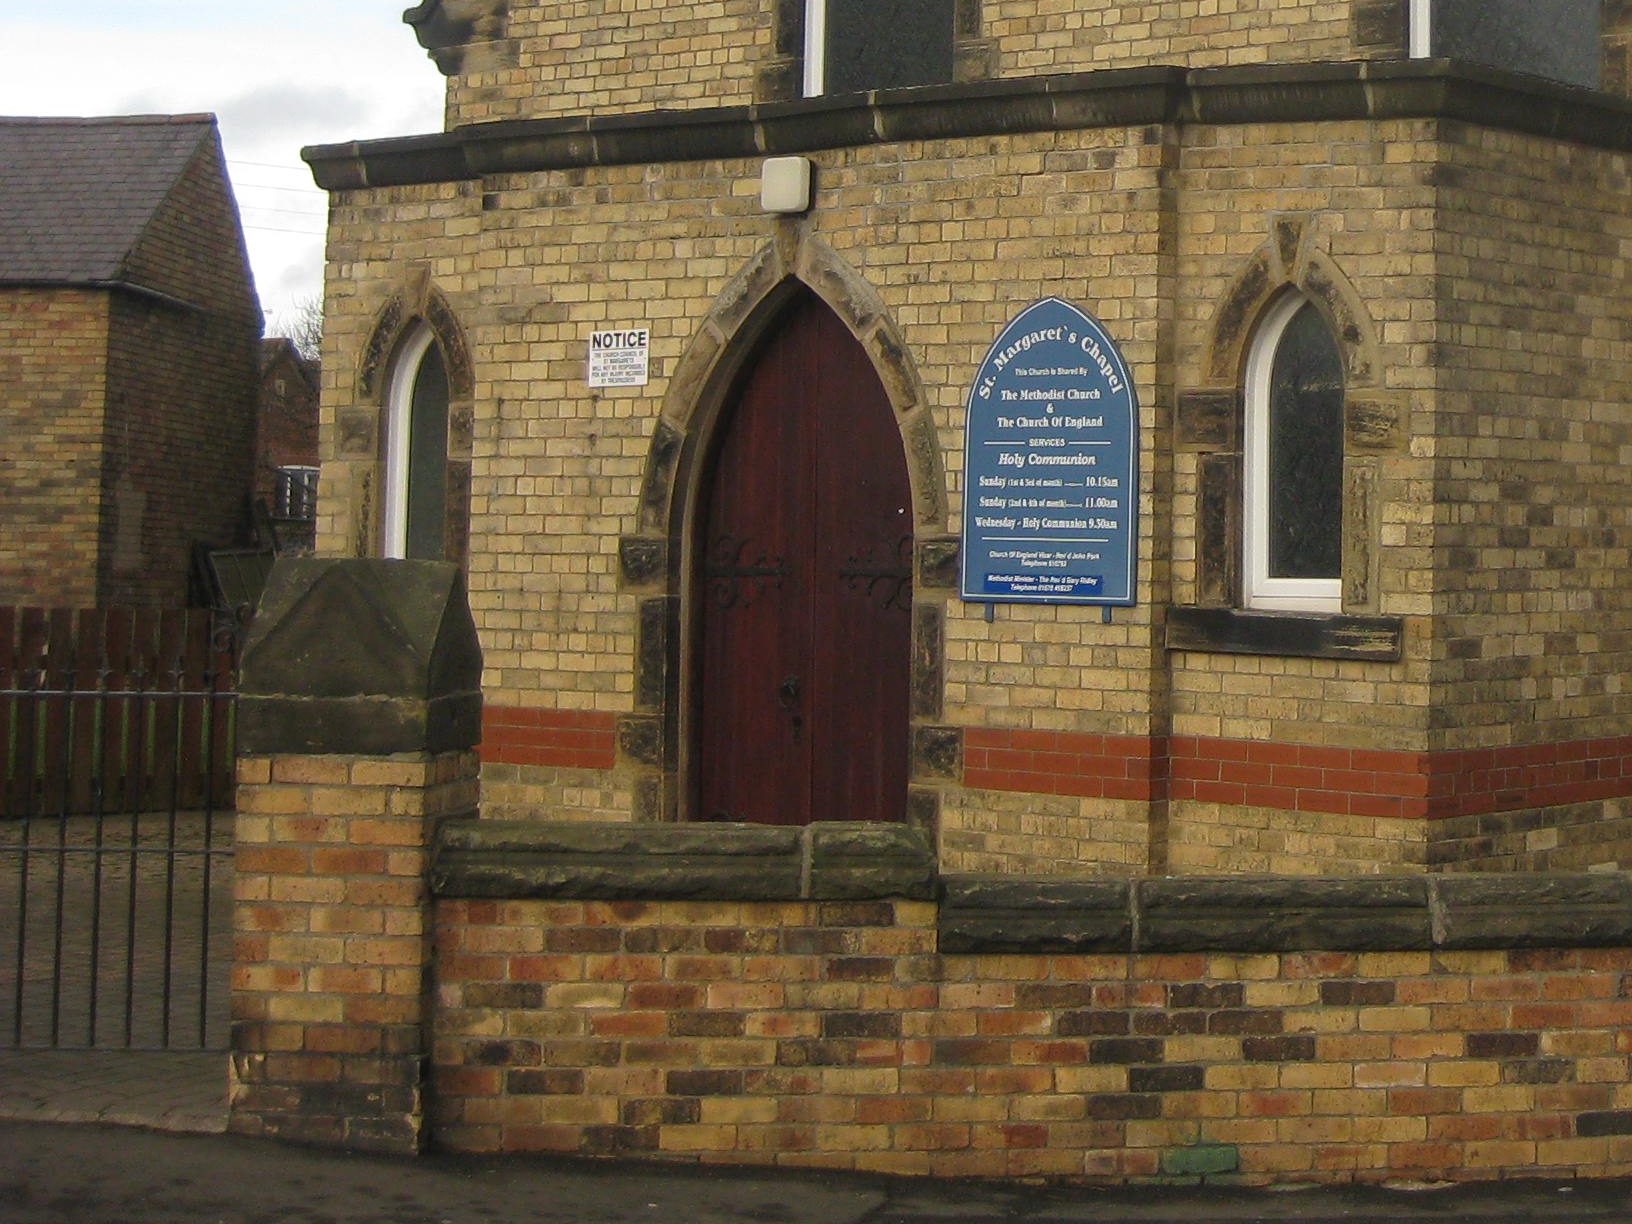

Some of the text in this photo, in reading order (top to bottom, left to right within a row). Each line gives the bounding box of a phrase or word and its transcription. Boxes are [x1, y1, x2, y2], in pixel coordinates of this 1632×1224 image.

[592, 331, 646, 348] NOTICE
[979, 376, 996, 399] St.
[1081, 336, 1124, 394] Chapel
[1015, 368, 1027, 376] This
[1028, 367, 1050, 376] Church
[1057, 367, 1078, 375] Shared
[1079, 367, 1088, 376] By
[1001, 388, 1101, 400] The Methodist Church
[1046, 403, 1054, 414] &
[997, 416, 1103, 429] The Church Of England
[1029, 438, 1066, 447] SERVICES
[998, 452, 1096, 468] Holy Communion
[979, 476, 1007, 488] Sunday
[1086, 476, 1119, 487] 10.15am
[979, 496, 1007, 509] Sunday
[1085, 497, 1118, 508] 11.00am
[975, 517, 1017, 530] Wednesday
[1022, 517, 1040, 530] Holy
[1042, 517, 1087, 529] Communion
[1016, 551, 1037, 559] England
[1021, 559, 1048, 568] Telephone
[1014, 575, 1035, 583] Minister
[1010, 583, 1038, 592] Telephone
